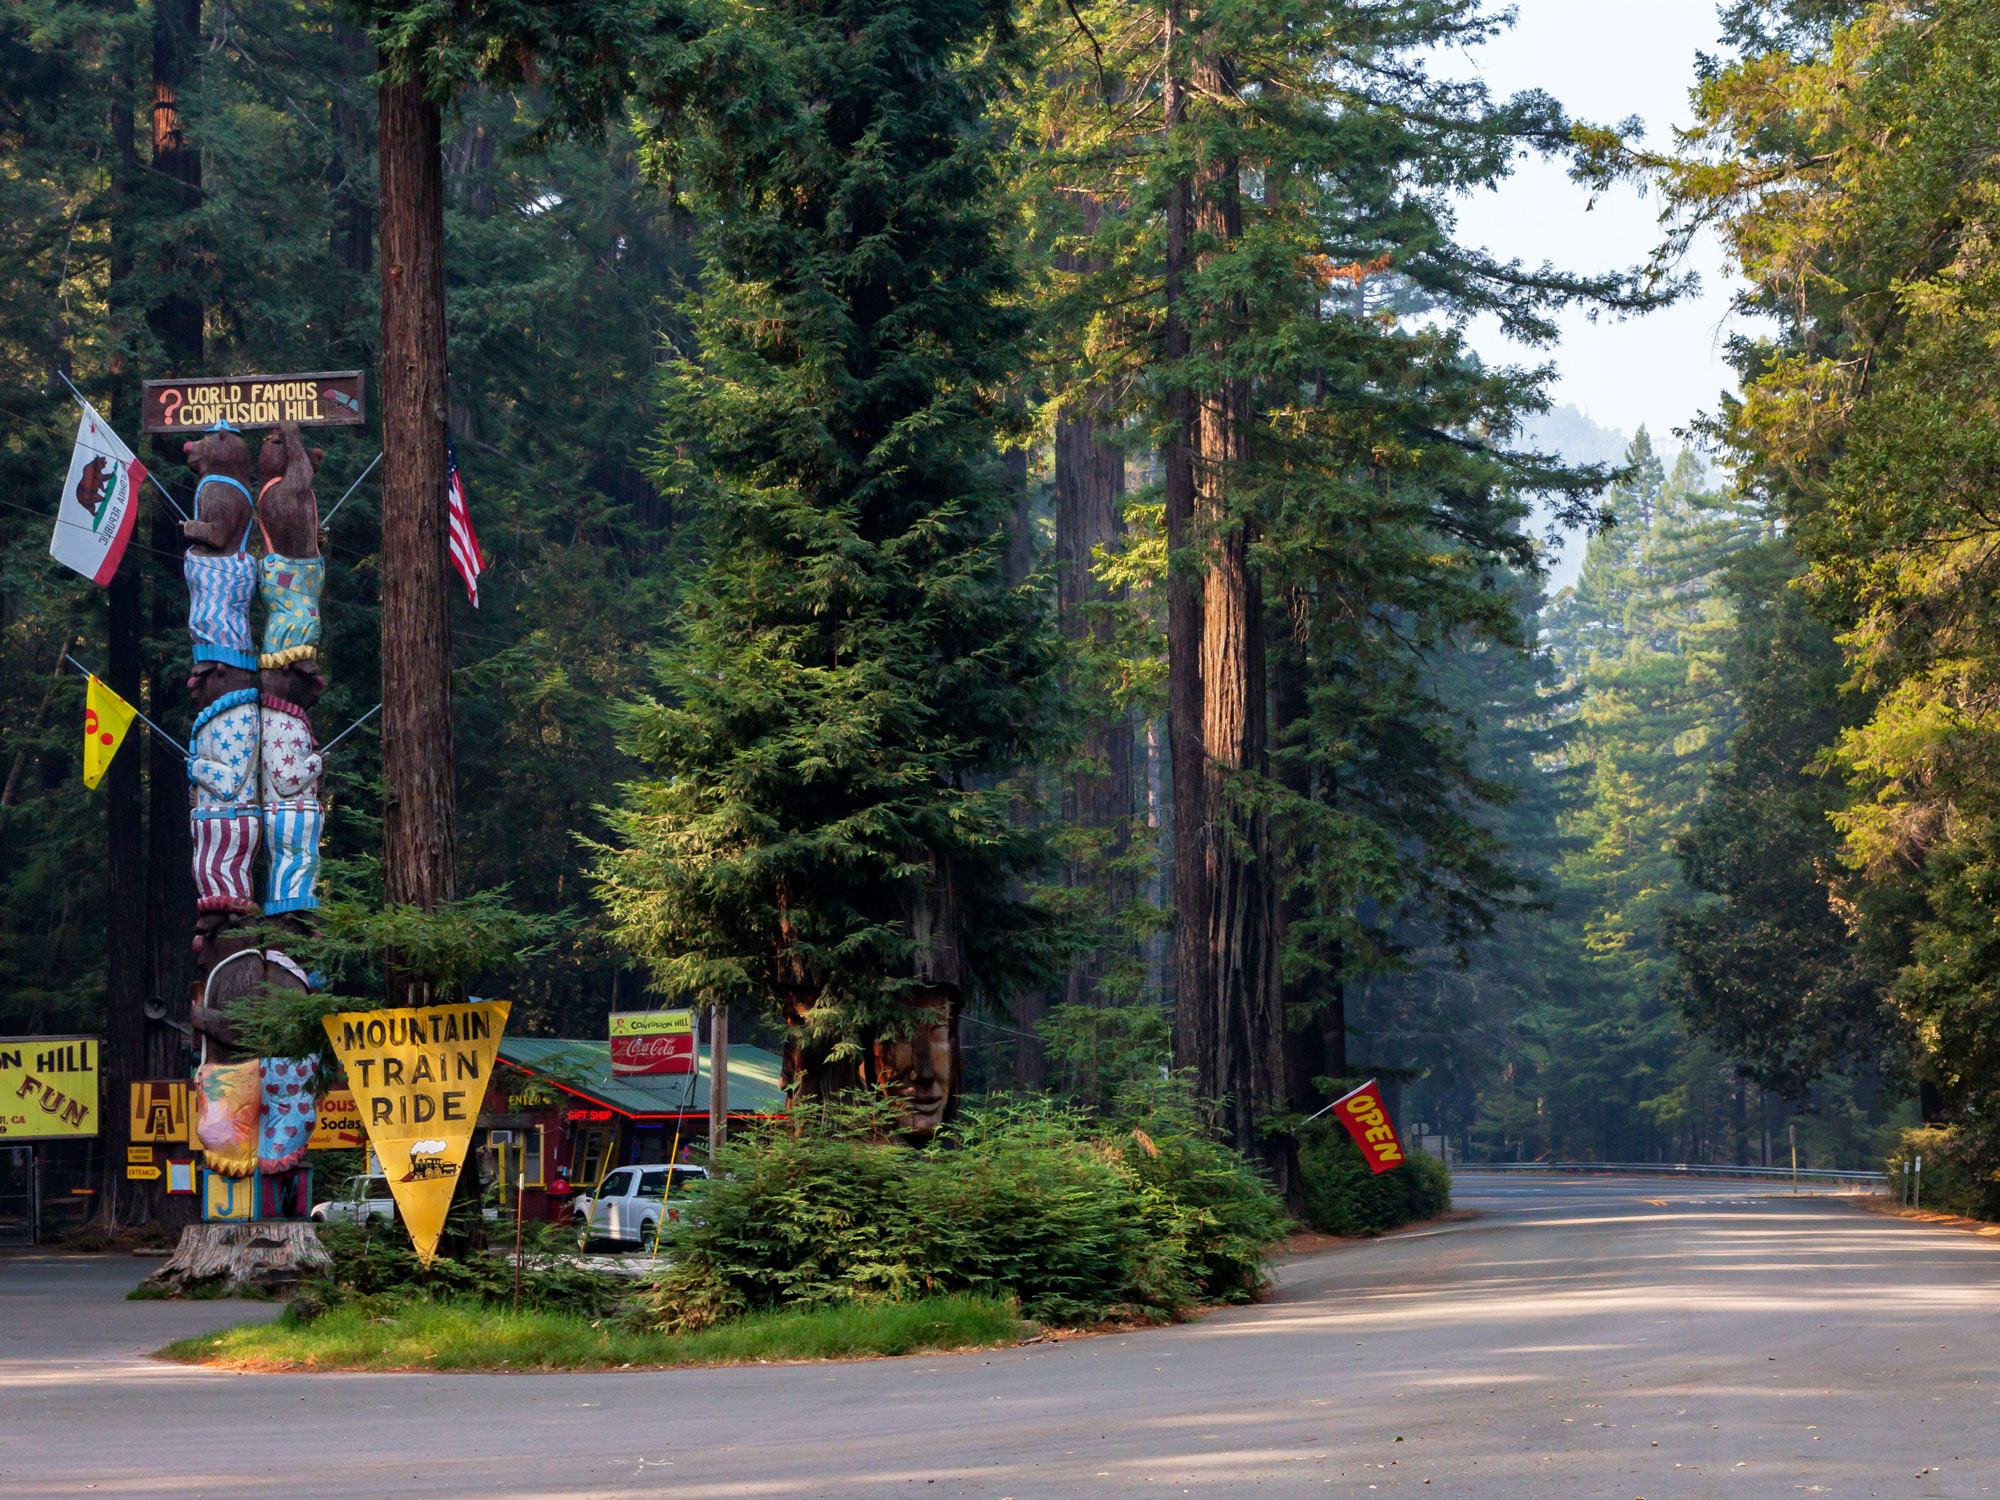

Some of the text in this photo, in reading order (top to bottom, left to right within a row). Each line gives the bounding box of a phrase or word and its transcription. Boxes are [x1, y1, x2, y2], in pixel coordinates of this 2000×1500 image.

[187, 382, 318, 405] WORLD FAMOUS
[179, 400, 324, 426] CONFUSION HILL
[343, 1011, 490, 1051] MOUNTAIN
[631, 1017, 689, 1030] CONFUSION HILL
[0, 1041, 93, 1073] N HILL
[354, 1050, 480, 1088] TRAIN
[16, 1074, 90, 1129] FUN
[317, 1096, 358, 1113] ous
[371, 1090, 467, 1127] RIDE
[11, 1116, 26, 1124] CA
[321, 1116, 361, 1130] Sodas
[568, 1110, 612, 1120] GIFT SHOP
[1346, 1095, 1402, 1161] OPEN
